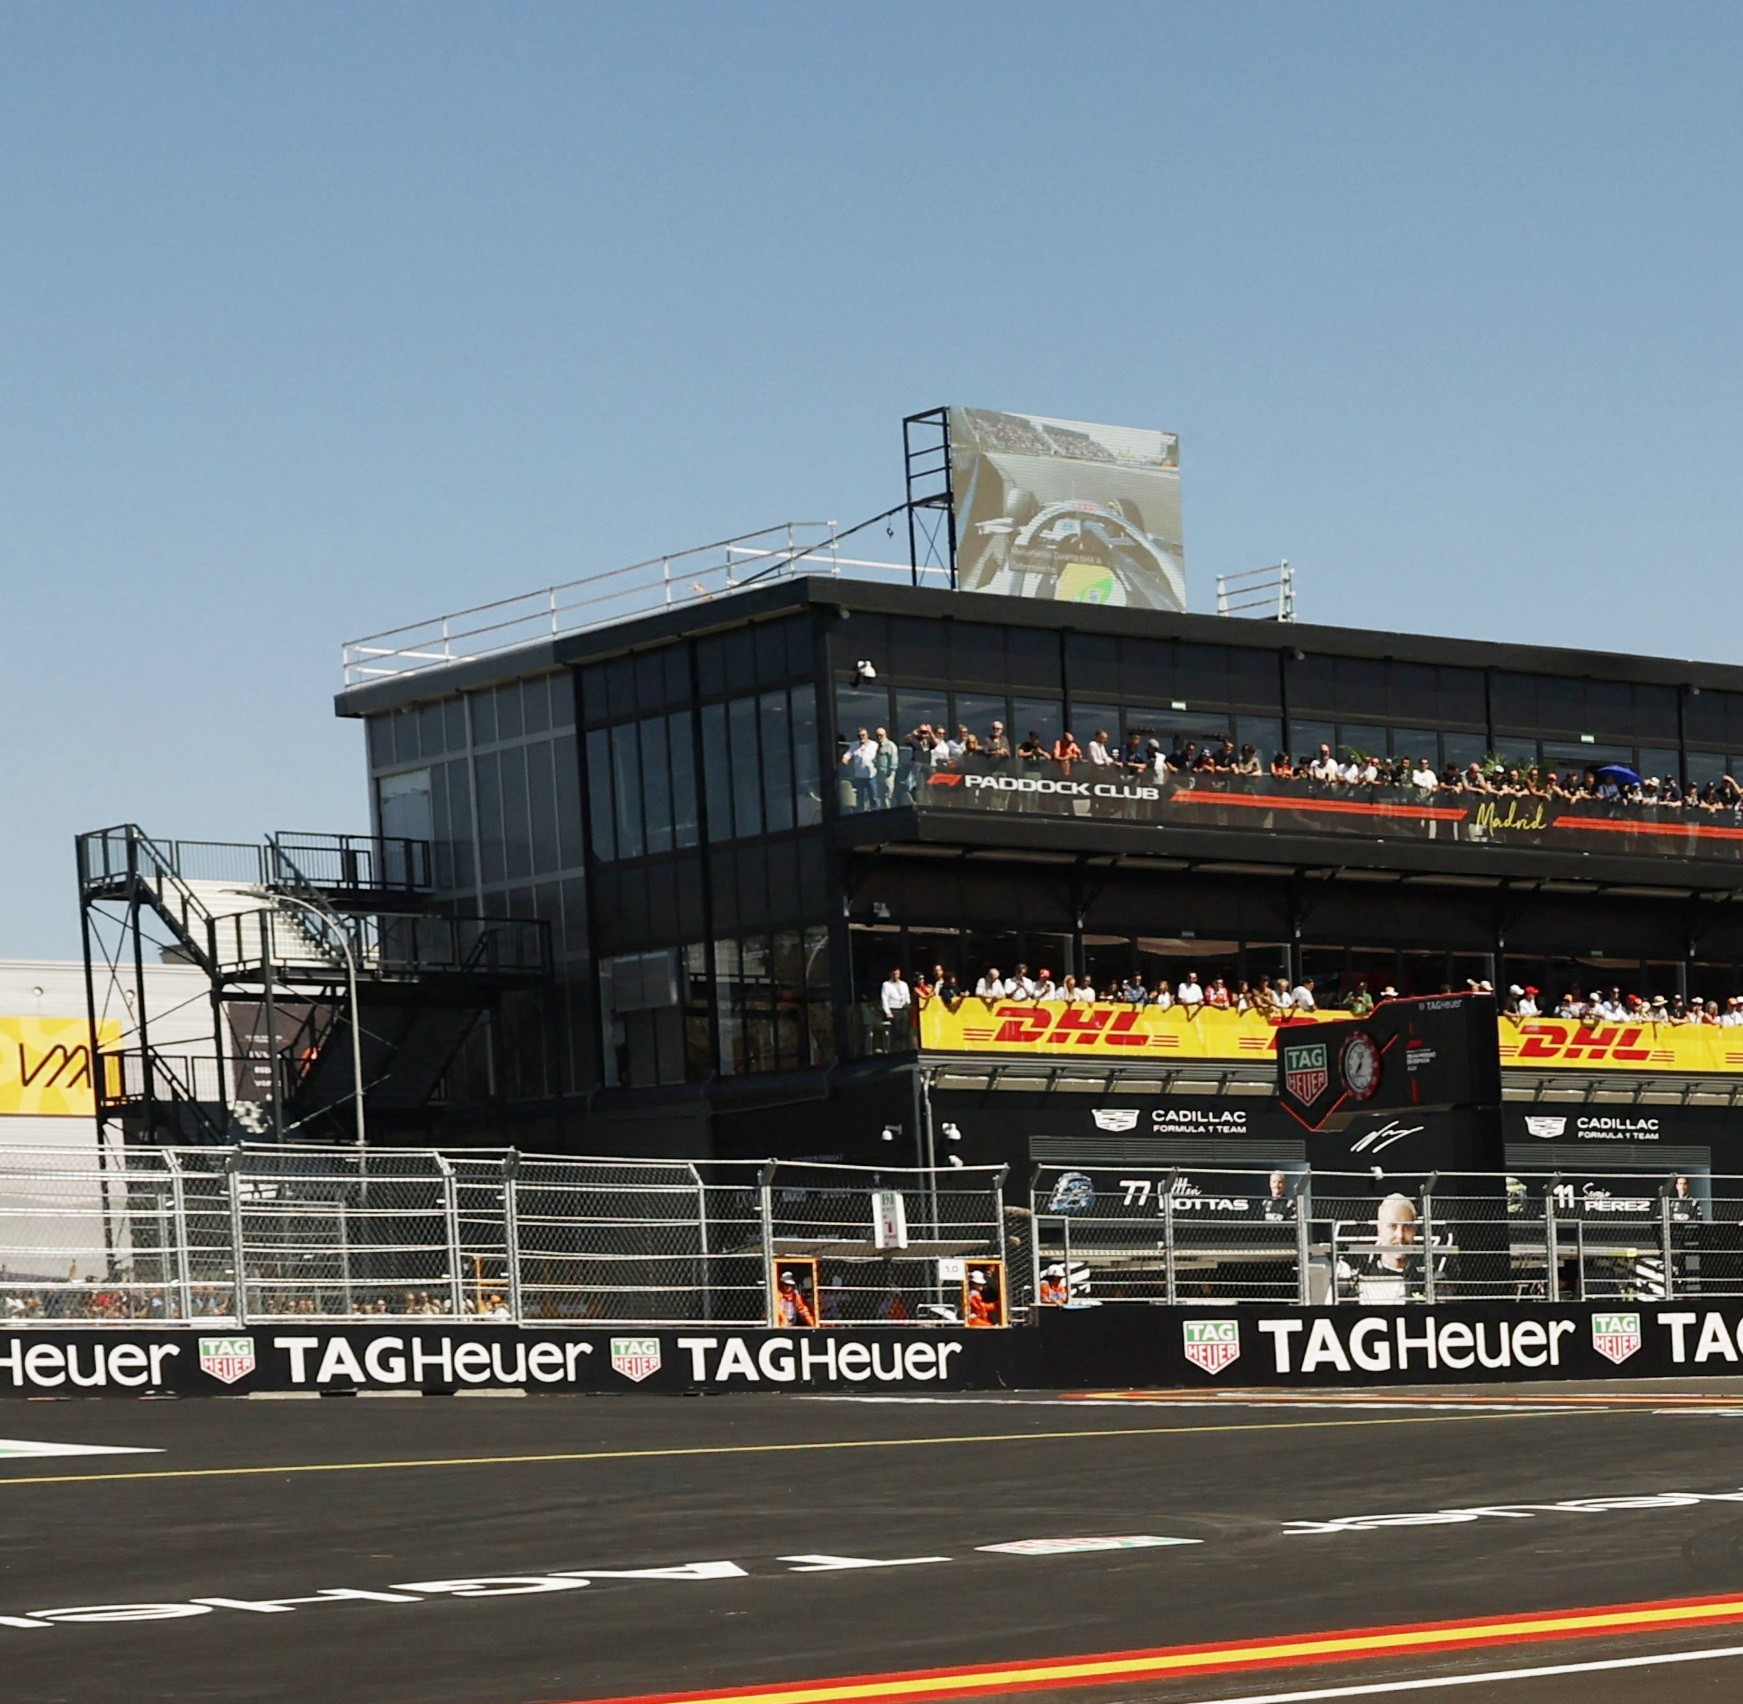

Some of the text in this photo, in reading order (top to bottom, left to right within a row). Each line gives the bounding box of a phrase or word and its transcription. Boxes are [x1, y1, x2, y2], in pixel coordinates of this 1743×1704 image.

[965, 775, 1089, 797] PADDOCK
[1094, 783, 1160, 801] CLUB
[1475, 801, 1547, 837] Madrid
[993, 1006, 1151, 1046] DHL
[1517, 1024, 1652, 1062] DHL
[1289, 1046, 1326, 1069] TAG
[1287, 1072, 1327, 1103] HEUER
[1151, 1110, 1247, 1124] CADILLAC
[1576, 1117, 1659, 1131] CADILLAC
[1152, 1124, 1206, 1134] FORMULA
[1217, 1125, 1247, 1134] TEAM
[1577, 1131, 1624, 1140] FORMULA
[1632, 1132, 1660, 1141] TEAM
[1118, 1180, 1152, 1207] 77
[1553, 1184, 1575, 1209] 11
[1584, 1200, 1651, 1212] PEREZ
[1187, 1324, 1235, 1342] TAG
[1595, 1316, 1637, 1333] TAG
[203, 1341, 250, 1355] TAG
[614, 1341, 657, 1355] TAG
[1187, 1344, 1238, 1369] HEUER
[1258, 1316, 1576, 1374] TAGHeuer
[1594, 1335, 1639, 1358] HEUER
[204, 1357, 253, 1379] HEUER
[274, 1336, 594, 1384] TAGHeuer
[614, 1356, 660, 1377] HEUER
[677, 1336, 963, 1383] TAGHeuer
